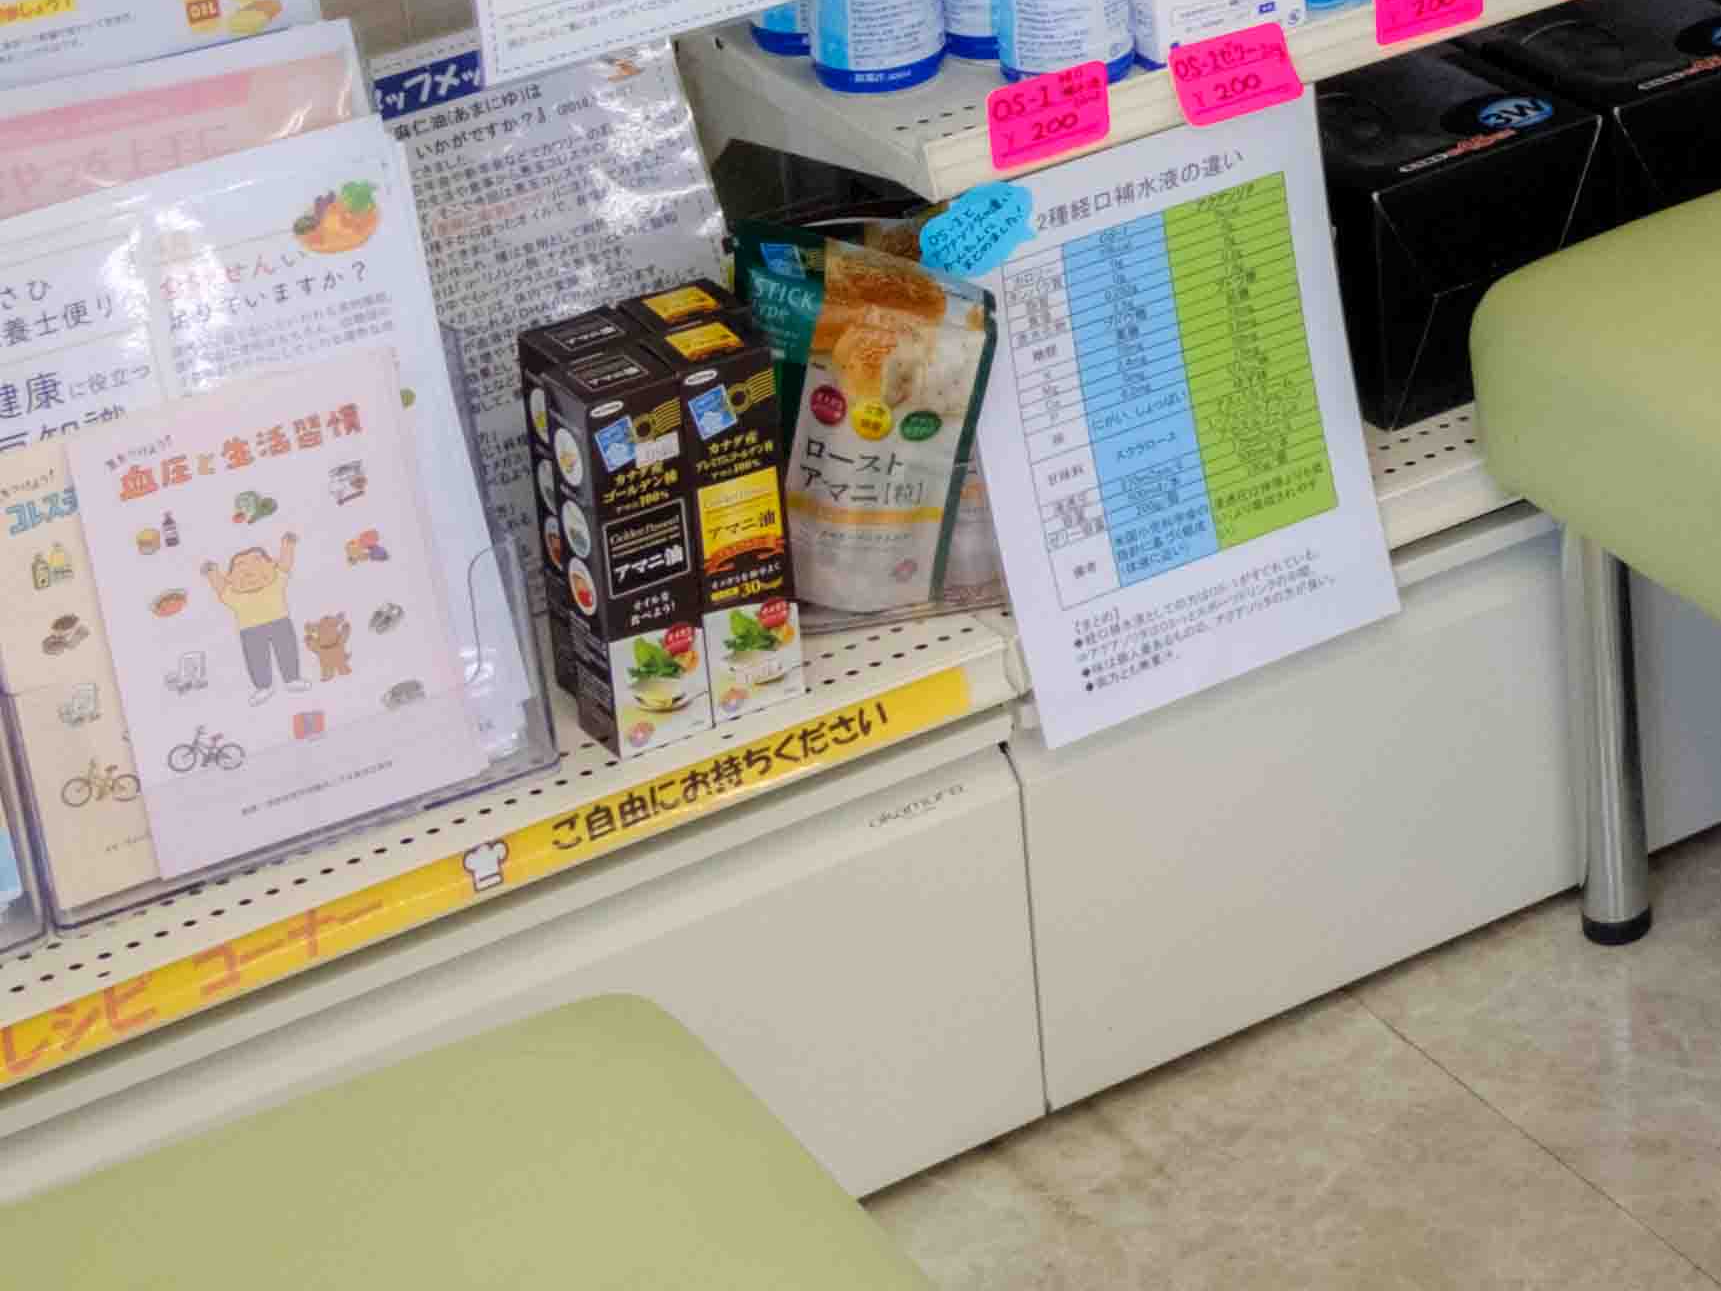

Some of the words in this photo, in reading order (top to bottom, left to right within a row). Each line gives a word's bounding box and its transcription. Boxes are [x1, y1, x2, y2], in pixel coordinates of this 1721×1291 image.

[1215, 72, 1264, 102] 200
[1030, 108, 1081, 141] 200
[119, 401, 363, 503] 血圧と生活習慣
[803, 438, 904, 476] ロースト
[706, 509, 777, 541] アマニ油
[613, 545, 685, 581] アマニ油
[550, 705, 890, 853] ご自由にお持ちください
[194, 896, 384, 996] コーナー
